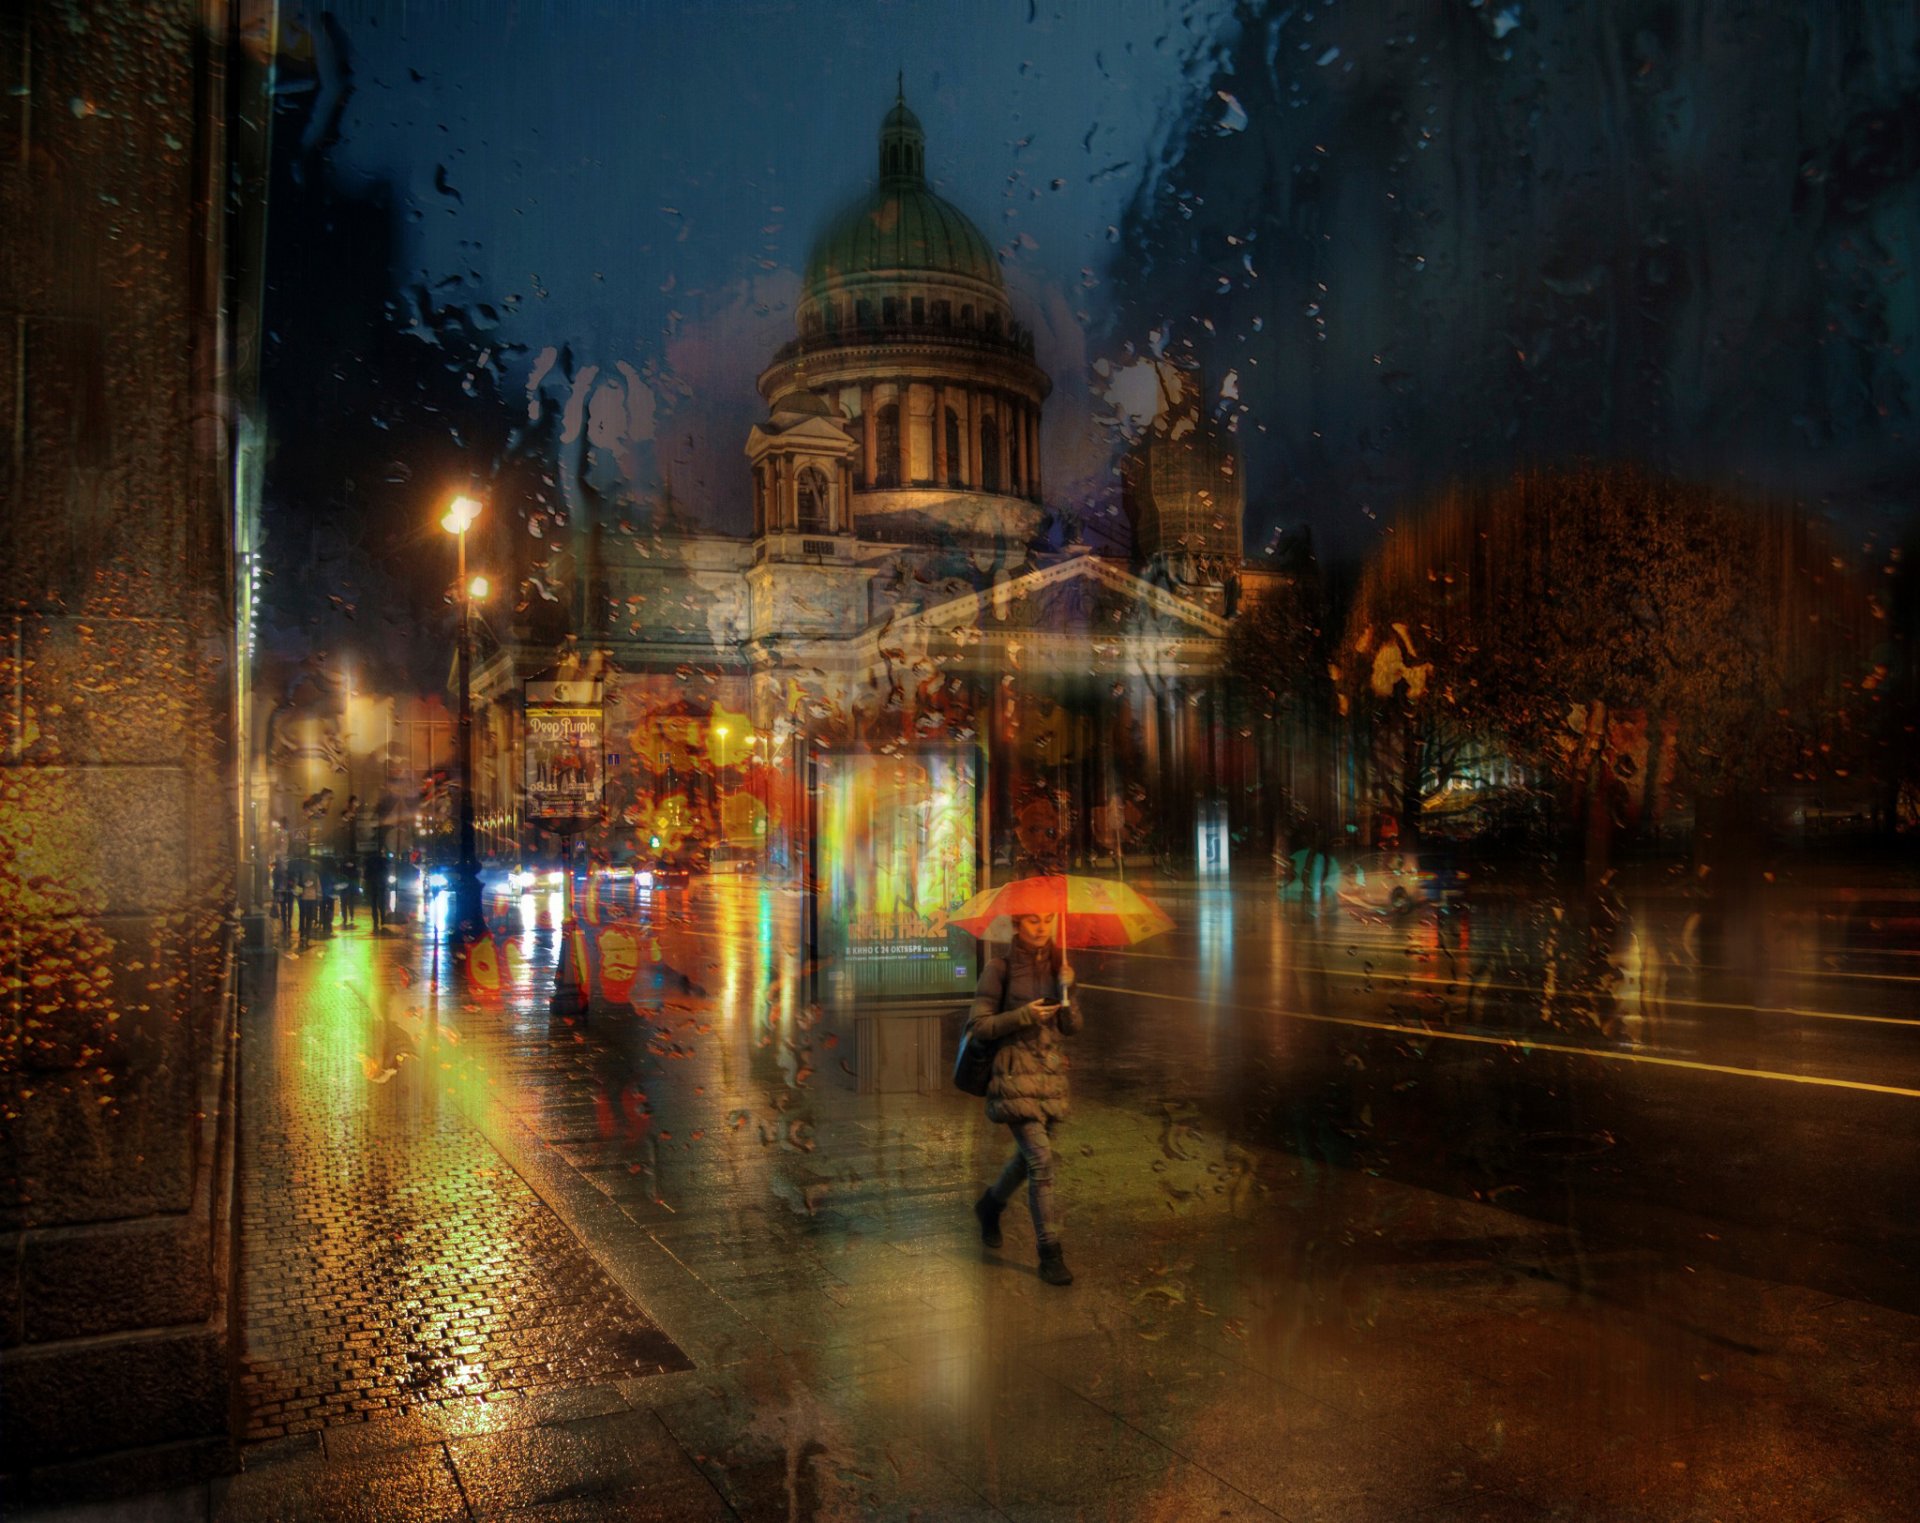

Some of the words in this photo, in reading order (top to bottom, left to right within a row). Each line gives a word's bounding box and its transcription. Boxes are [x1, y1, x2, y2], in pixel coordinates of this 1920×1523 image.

[530, 718, 560, 739] Deep
[561, 717, 596, 739] Purple
[530, 781, 558, 792] 08.11
[853, 947, 873, 955] КИНО
[881, 946, 889, 954] 24
[890, 945, 922, 953] ОКТЯБРЯ
